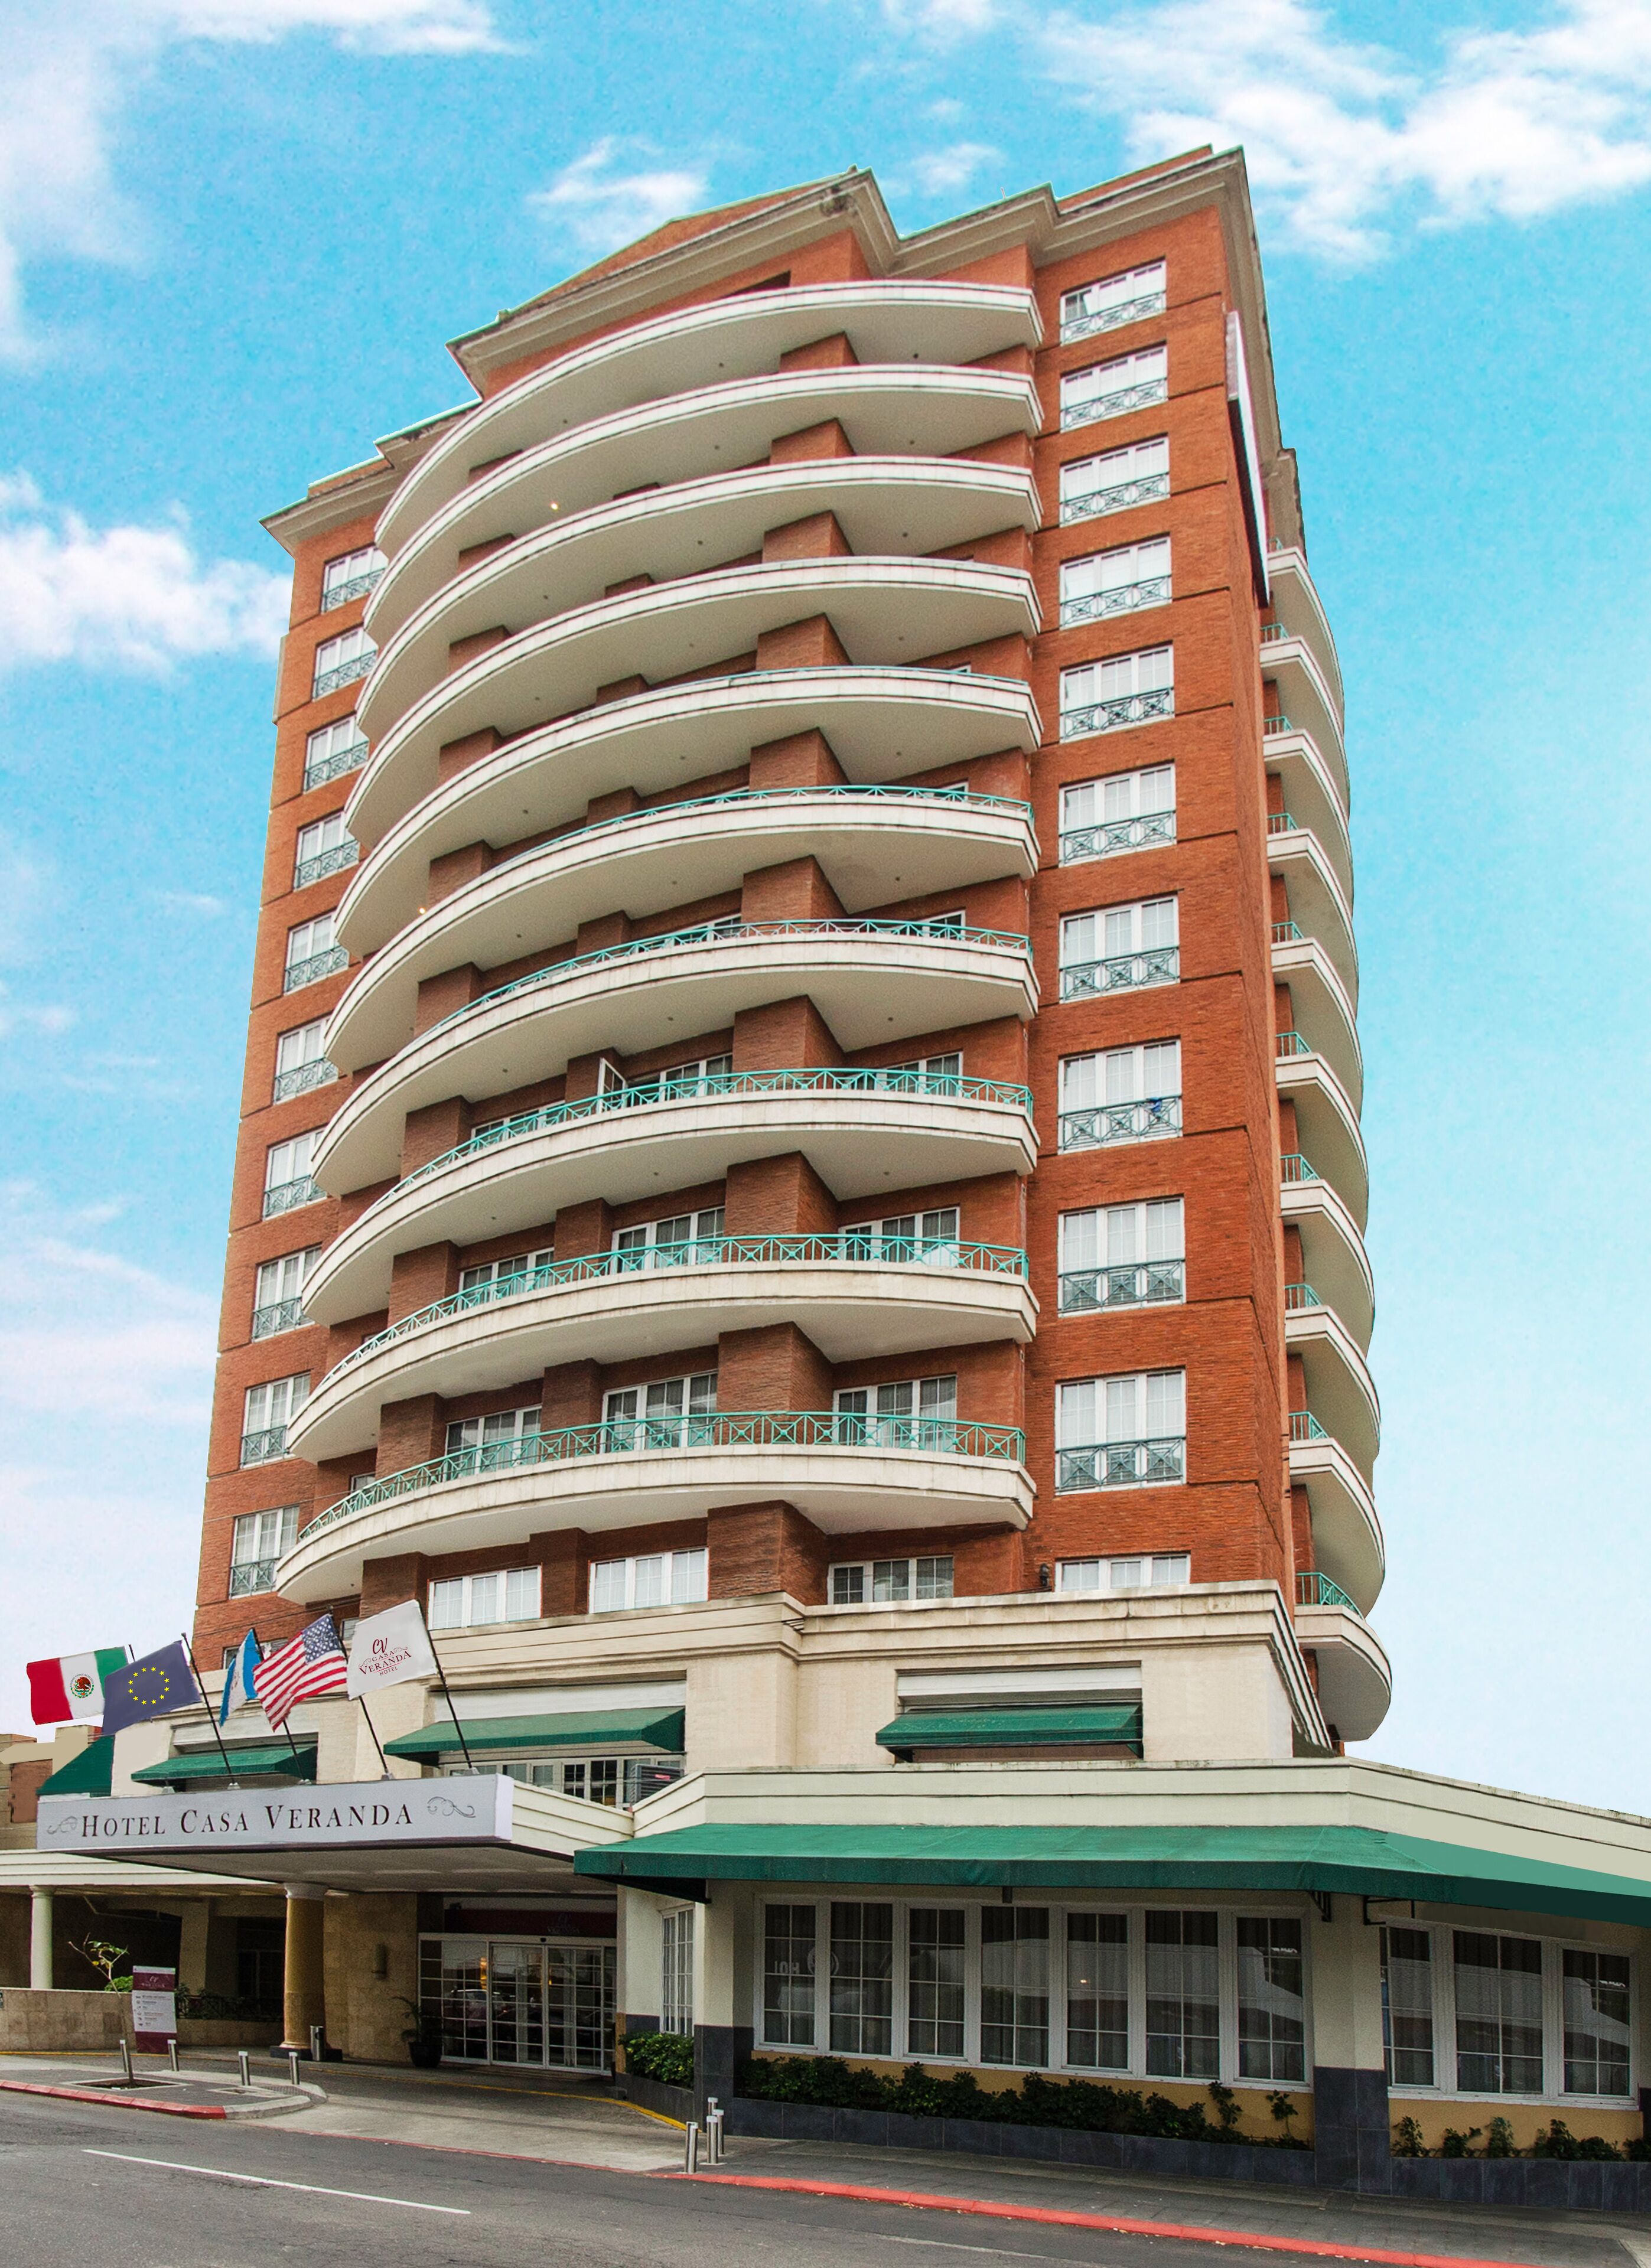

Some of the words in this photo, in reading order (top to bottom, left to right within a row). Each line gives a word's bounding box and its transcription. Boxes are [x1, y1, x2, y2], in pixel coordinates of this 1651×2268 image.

[359, 1650, 412, 1674] VERANDA
[372, 1650, 395, 1662] CASA
[379, 1666, 398, 1676] HOTEL
[82, 1815, 166, 1837] HOTEL
[181, 1809, 249, 1833] CASA
[265, 1803, 413, 1829] VERANDA
